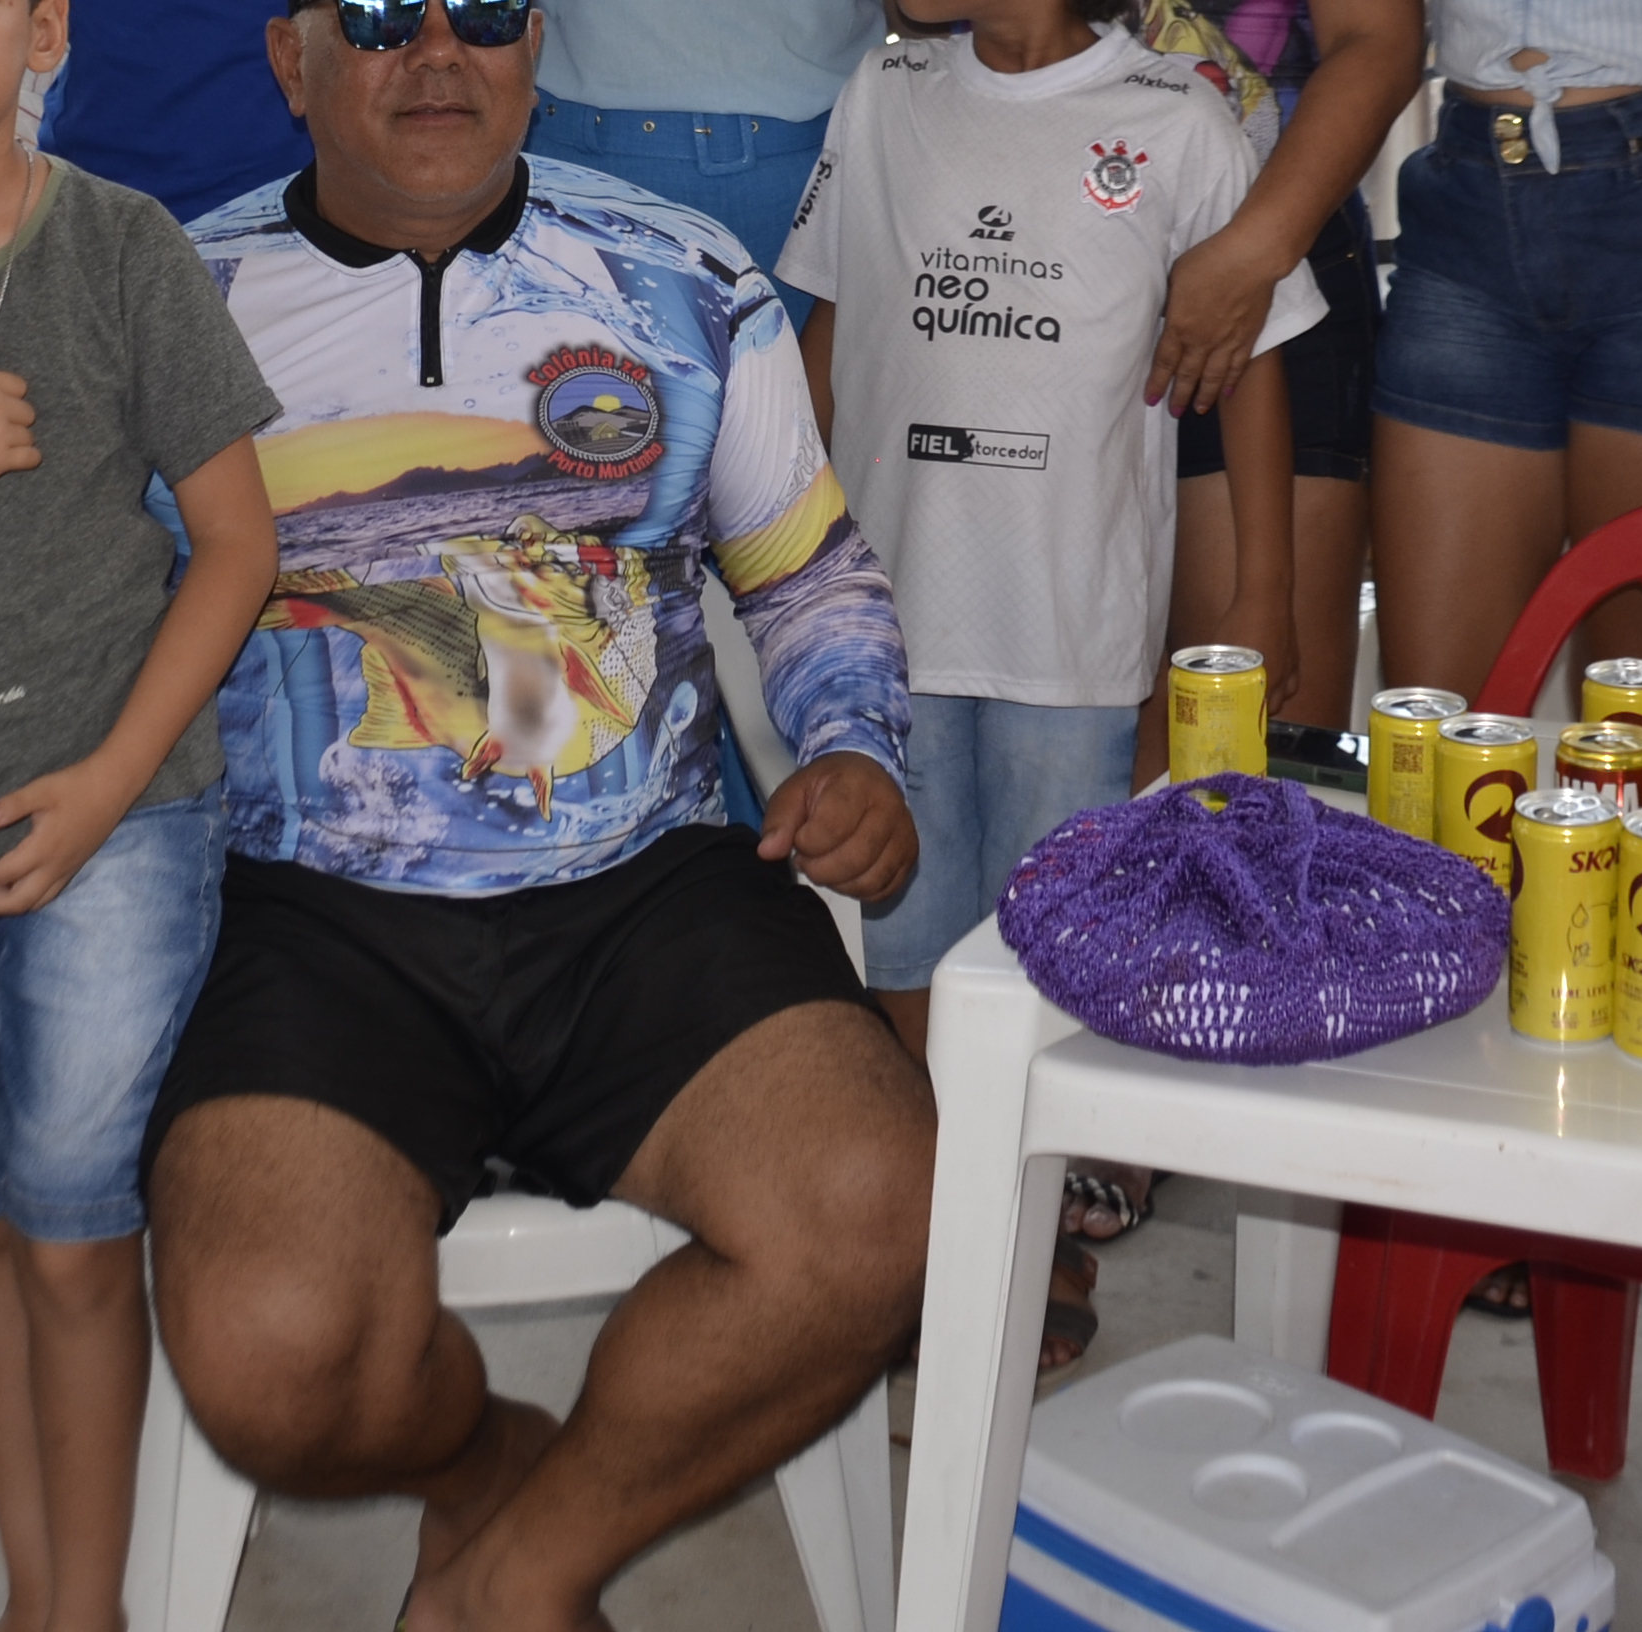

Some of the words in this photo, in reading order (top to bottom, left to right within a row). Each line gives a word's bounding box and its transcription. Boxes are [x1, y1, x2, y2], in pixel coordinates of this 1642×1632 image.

[968, 228, 1016, 242] ALE
[920, 247, 1064, 280] vitaminas
[914, 273, 989, 302] neo
[912, 302, 1061, 343] química
[528, 345, 615, 386] Colônia
[548, 450, 595, 479] Porto
[598, 442, 665, 480] Murtinho
[910, 433, 960, 456] FIEL
[975, 440, 1045, 461] torcedor
